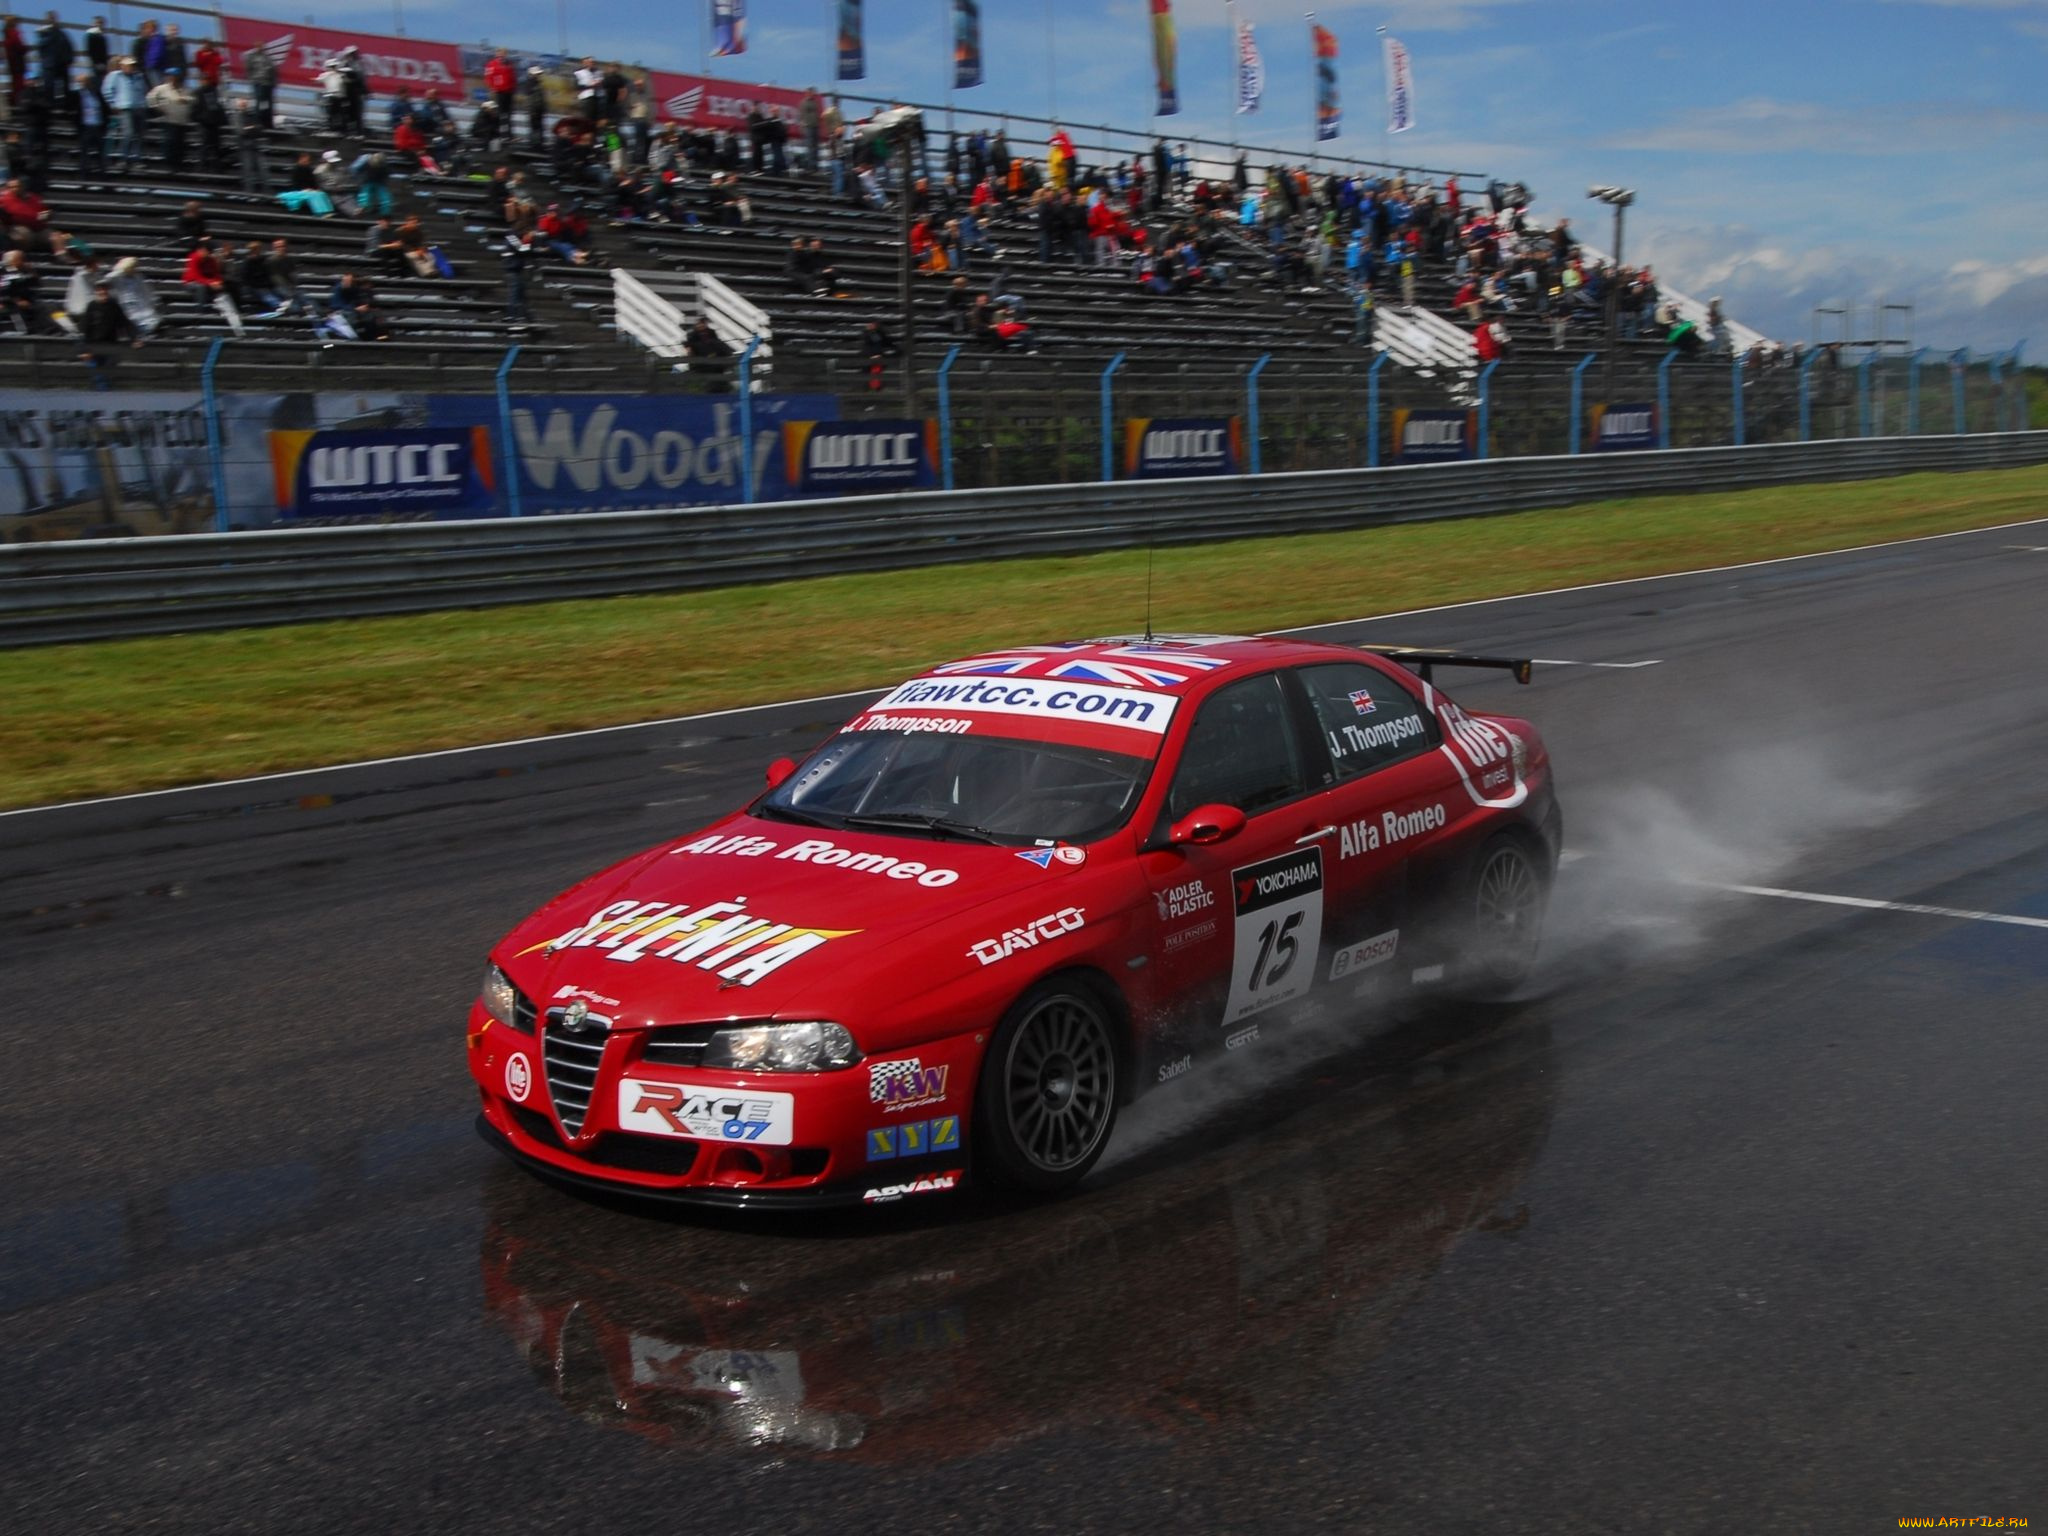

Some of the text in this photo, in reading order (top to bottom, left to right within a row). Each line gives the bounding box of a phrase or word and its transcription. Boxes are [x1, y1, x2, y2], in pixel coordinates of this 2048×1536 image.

[300, 45, 456, 84] HNDA
[810, 432, 919, 468] WTCC
[1144, 429, 1226, 459] WTCC
[309, 443, 462, 488] WTCC
[888, 680, 1156, 723] fiawtcc.com
[840, 714, 973, 735] J. Thompson
[1329, 713, 1425, 759] J. Thompson
[1438, 703, 1508, 767] life
[1340, 803, 1446, 860] Alfa Romeo
[670, 834, 960, 888] Alfa Romeo
[1256, 861, 1319, 896] YOKOHAMA
[1169, 880, 1204, 904] ADLER
[1170, 891, 1215, 919] PLASTIC
[966, 906, 1085, 966] DAYCO
[1248, 910, 1306, 992] 15
[1354, 936, 1396, 965] BOSCH
[884, 1065, 949, 1104] KW
[632, 1083, 774, 1134] RACE
[722, 1119, 772, 1140] 07
[863, 1176, 955, 1199] ADVAN
